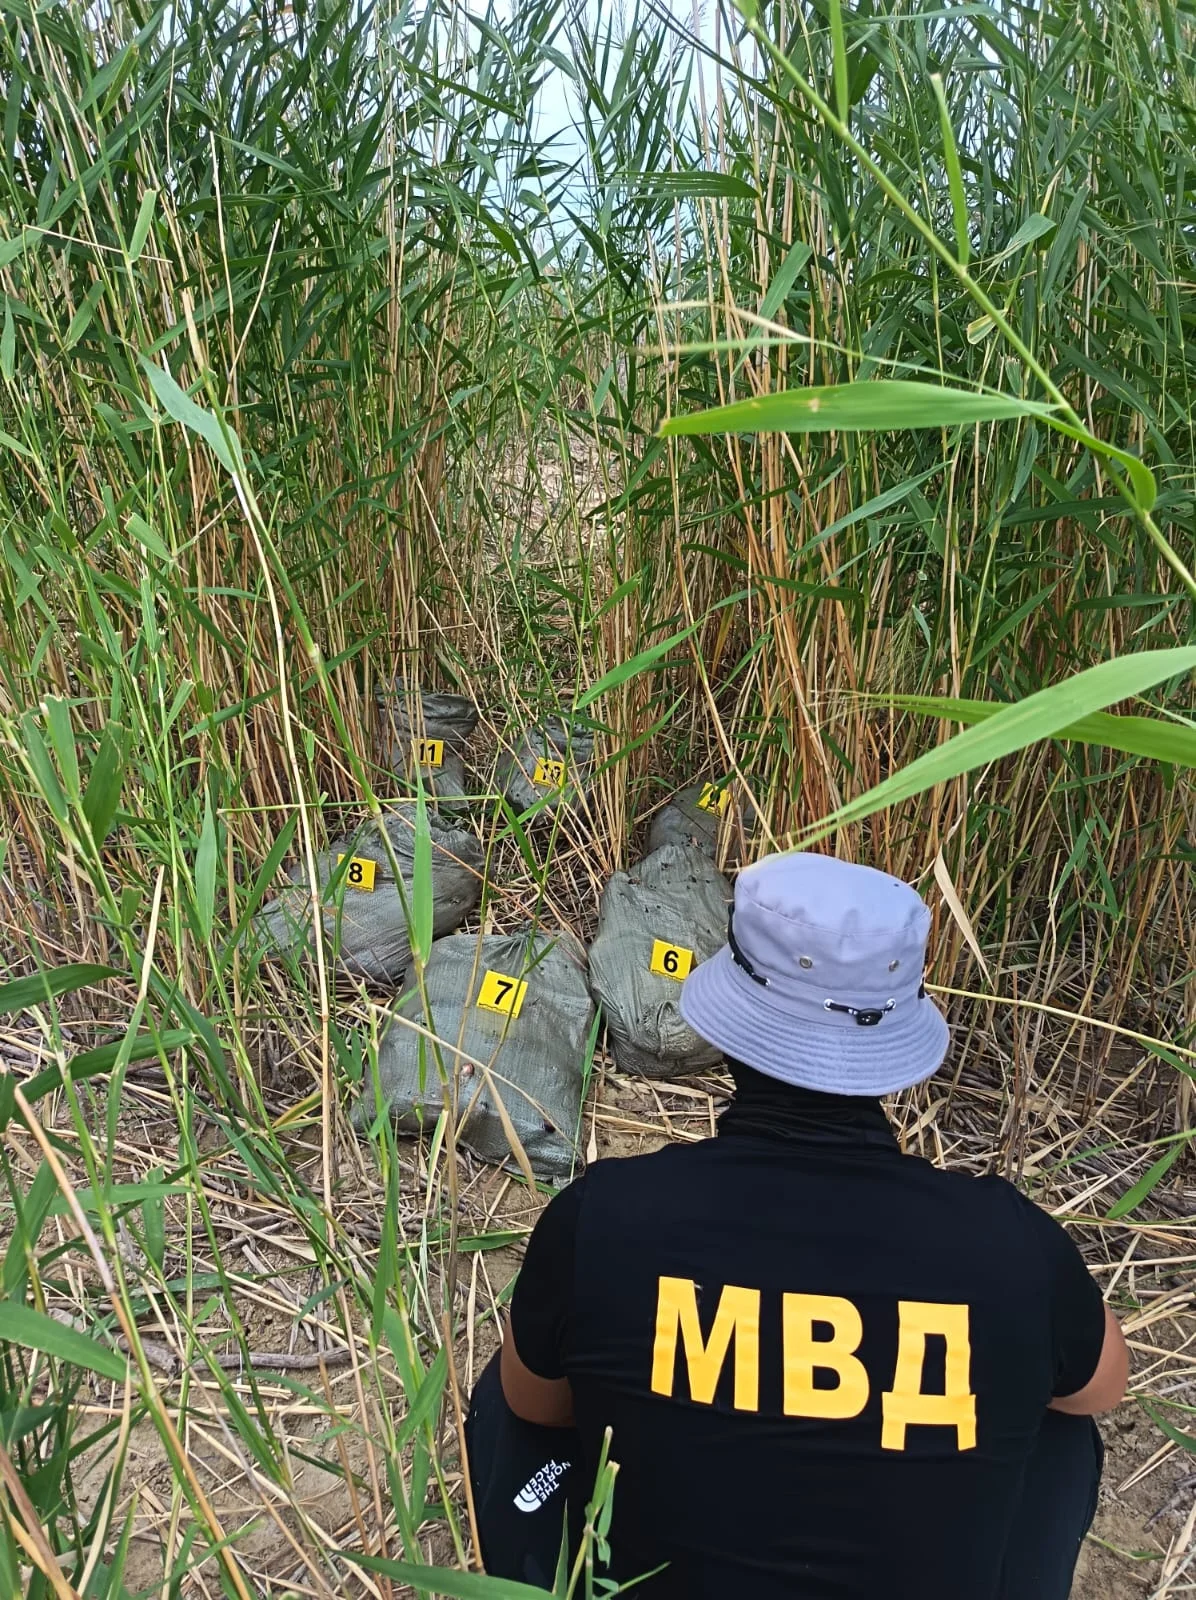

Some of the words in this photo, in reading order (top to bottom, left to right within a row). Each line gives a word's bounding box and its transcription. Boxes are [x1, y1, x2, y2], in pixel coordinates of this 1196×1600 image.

[420, 743, 436, 762] 11
[349, 862, 363, 883] 8
[663, 949, 679, 973] 6
[494, 979, 514, 1005] 7
[651, 1276, 977, 1451] МВД
[529, 1459, 557, 1489] FACE
[534, 1461, 571, 1496] NORTH
[540, 1480, 560, 1502] THE
